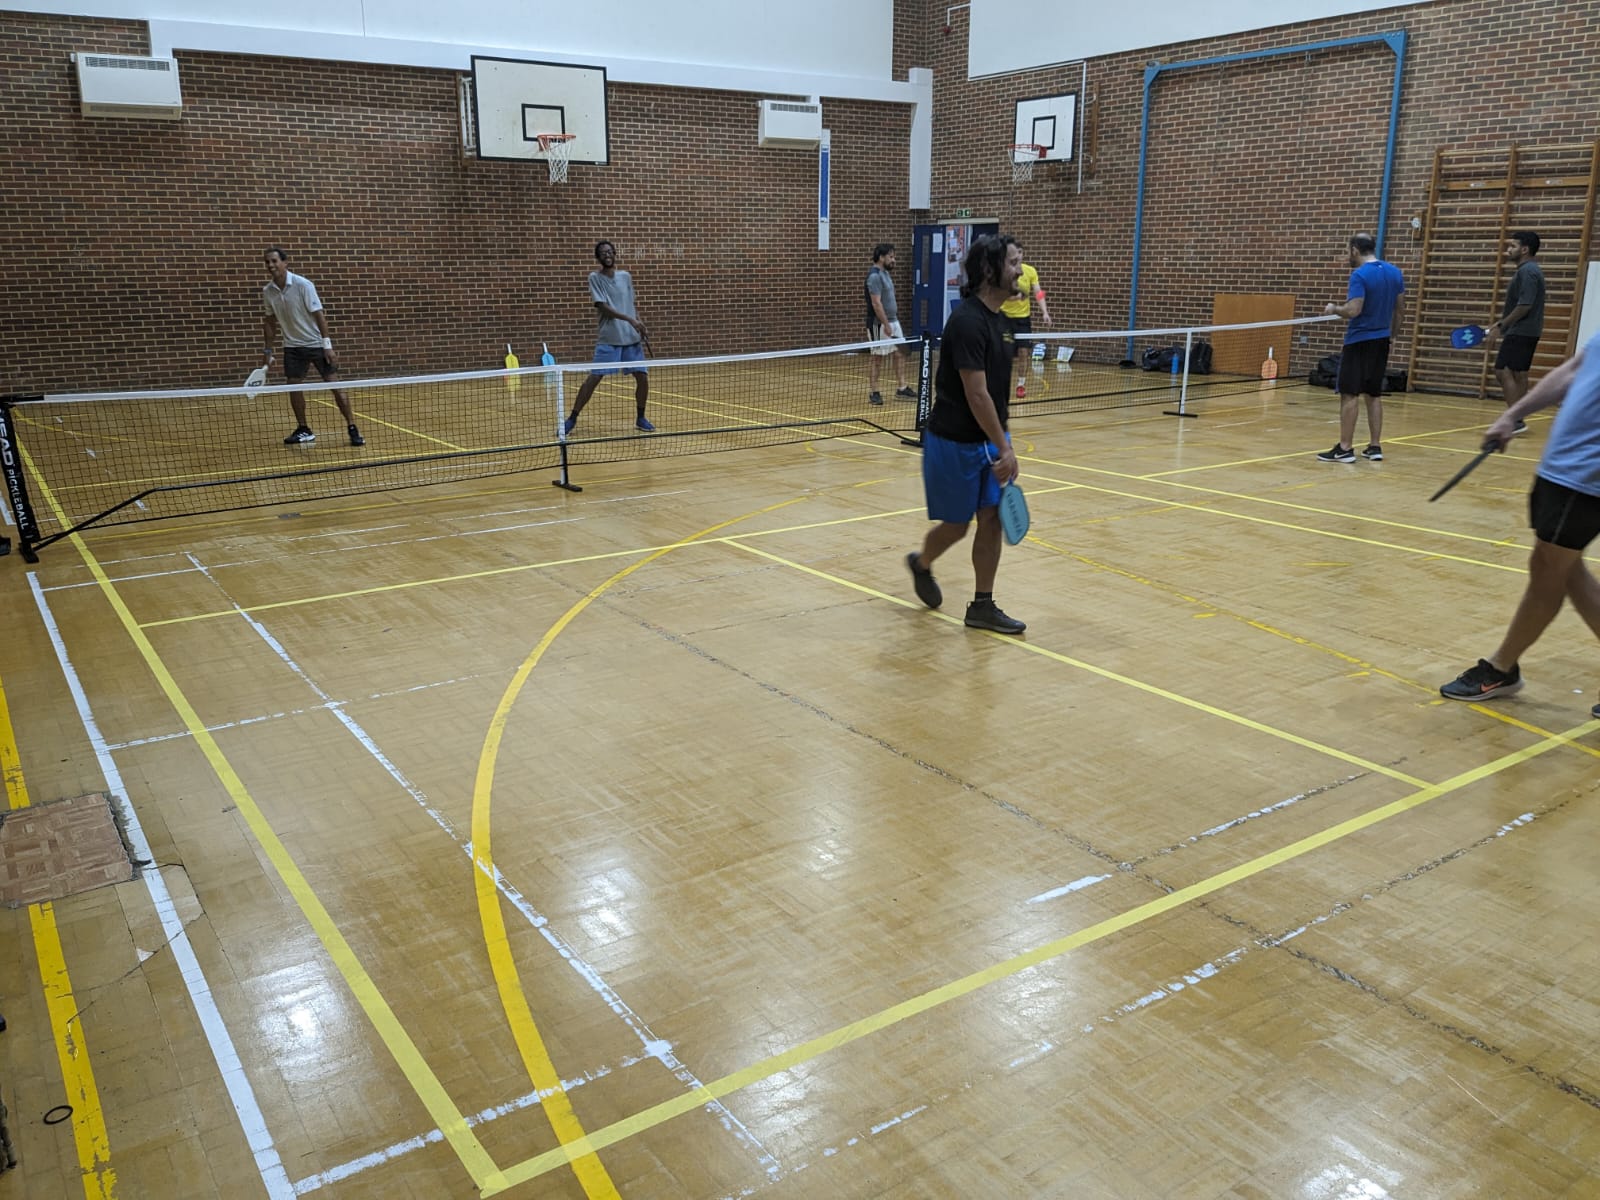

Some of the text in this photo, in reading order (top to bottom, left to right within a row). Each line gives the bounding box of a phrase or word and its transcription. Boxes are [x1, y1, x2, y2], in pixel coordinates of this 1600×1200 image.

[922, 340, 930, 378] HEAD
[919, 380, 927, 421] PICKLEBALL
[7, 469, 30, 530] PICKLEBALL
